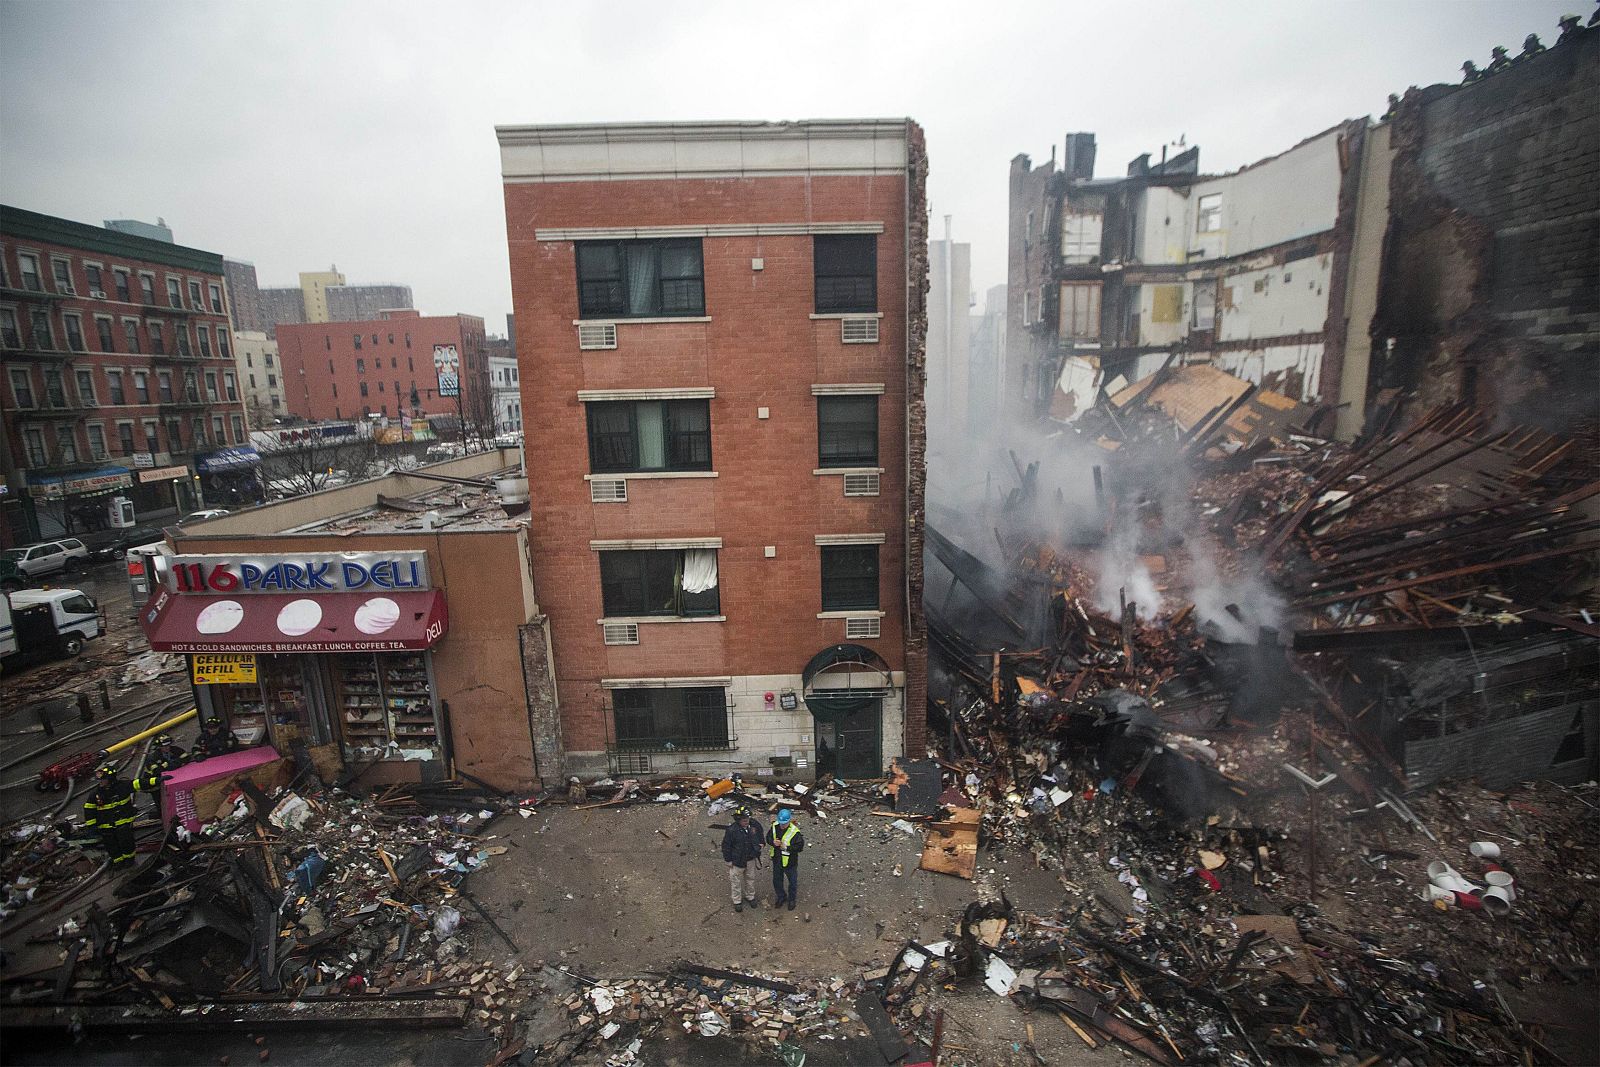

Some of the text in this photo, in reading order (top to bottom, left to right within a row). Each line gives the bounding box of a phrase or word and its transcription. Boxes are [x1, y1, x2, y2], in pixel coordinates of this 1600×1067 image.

[172, 560, 421, 591] 116 PARK DELI
[426, 620, 442, 643] DELI
[275, 643, 323, 651] BREAKFAST.
[354, 642, 387, 650] COFFEE.
[388, 641, 407, 649] TEA.
[197, 654, 252, 664] CELLULAR
[197, 665, 234, 674] REFILL
